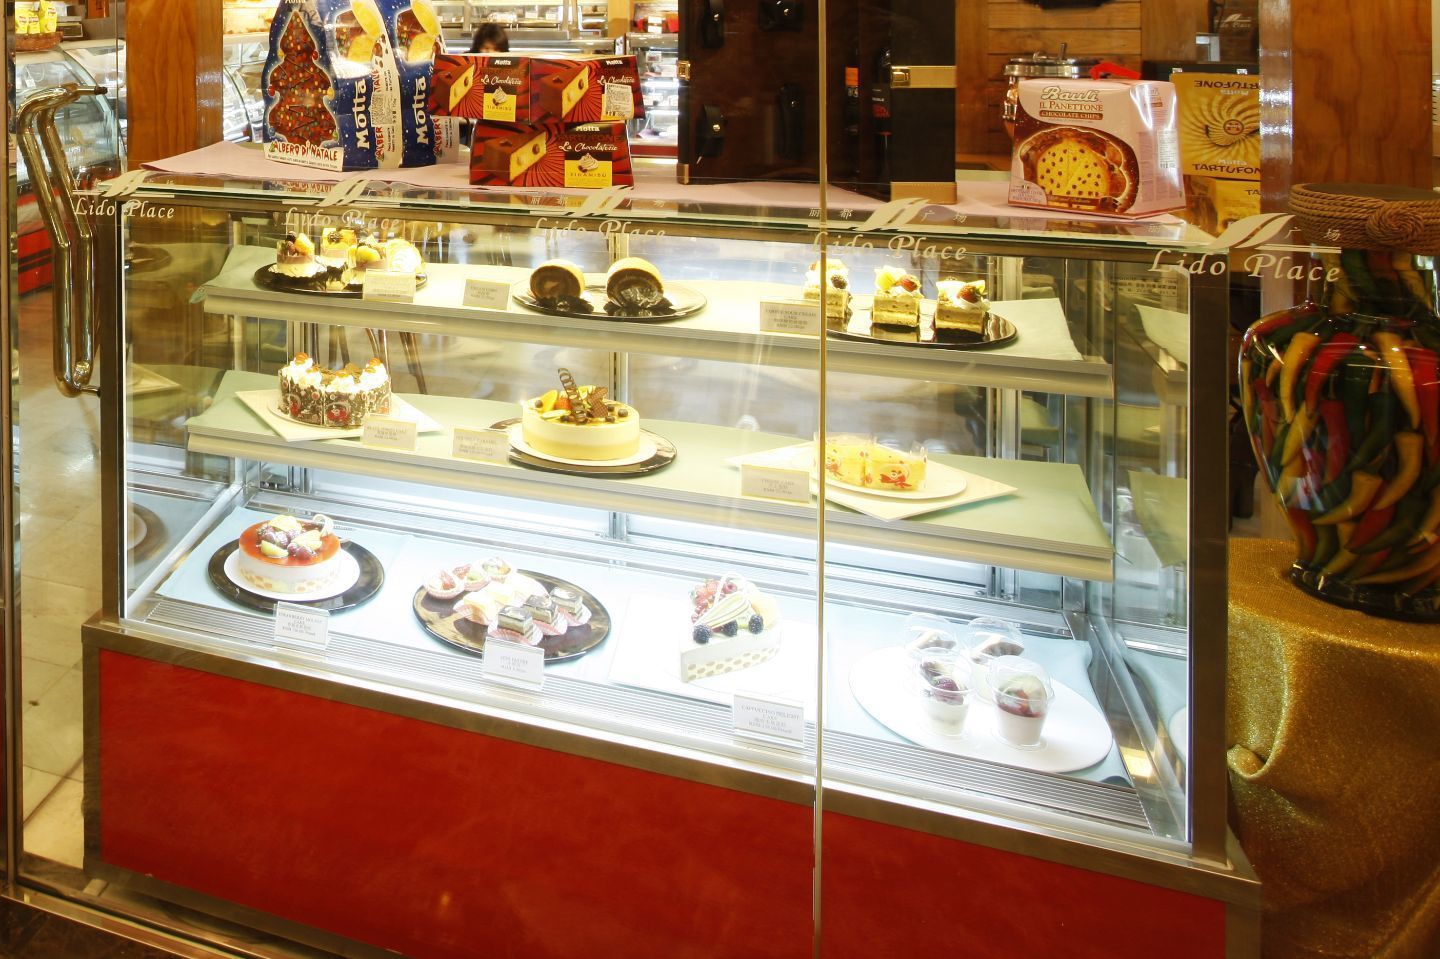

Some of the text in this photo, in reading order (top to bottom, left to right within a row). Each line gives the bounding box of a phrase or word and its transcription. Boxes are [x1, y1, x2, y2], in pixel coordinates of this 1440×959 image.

[494, 58, 512, 66] Motta
[1041, 86, 1100, 102] Bauli
[352, 78, 370, 150] Motta
[412, 76, 429, 145] Motta
[1041, 110, 1079, 119] CHOCOLATE
[1049, 100, 1103, 112] PANETTONE
[269, 140, 299, 156] ALBERO
[309, 144, 338, 161] NATALE
[375, 126, 385, 160] ALBER
[559, 141, 618, 152] La Chocolaterie
[1193, 163, 1261, 175] TARTUFON
[75, 197, 175, 218] Lido Place
[281, 206, 400, 230] Lido Place
[535, 217, 667, 242] Lido Place
[812, 231, 967, 261] Lido Place
[1147, 248, 1340, 283] Lido Place
